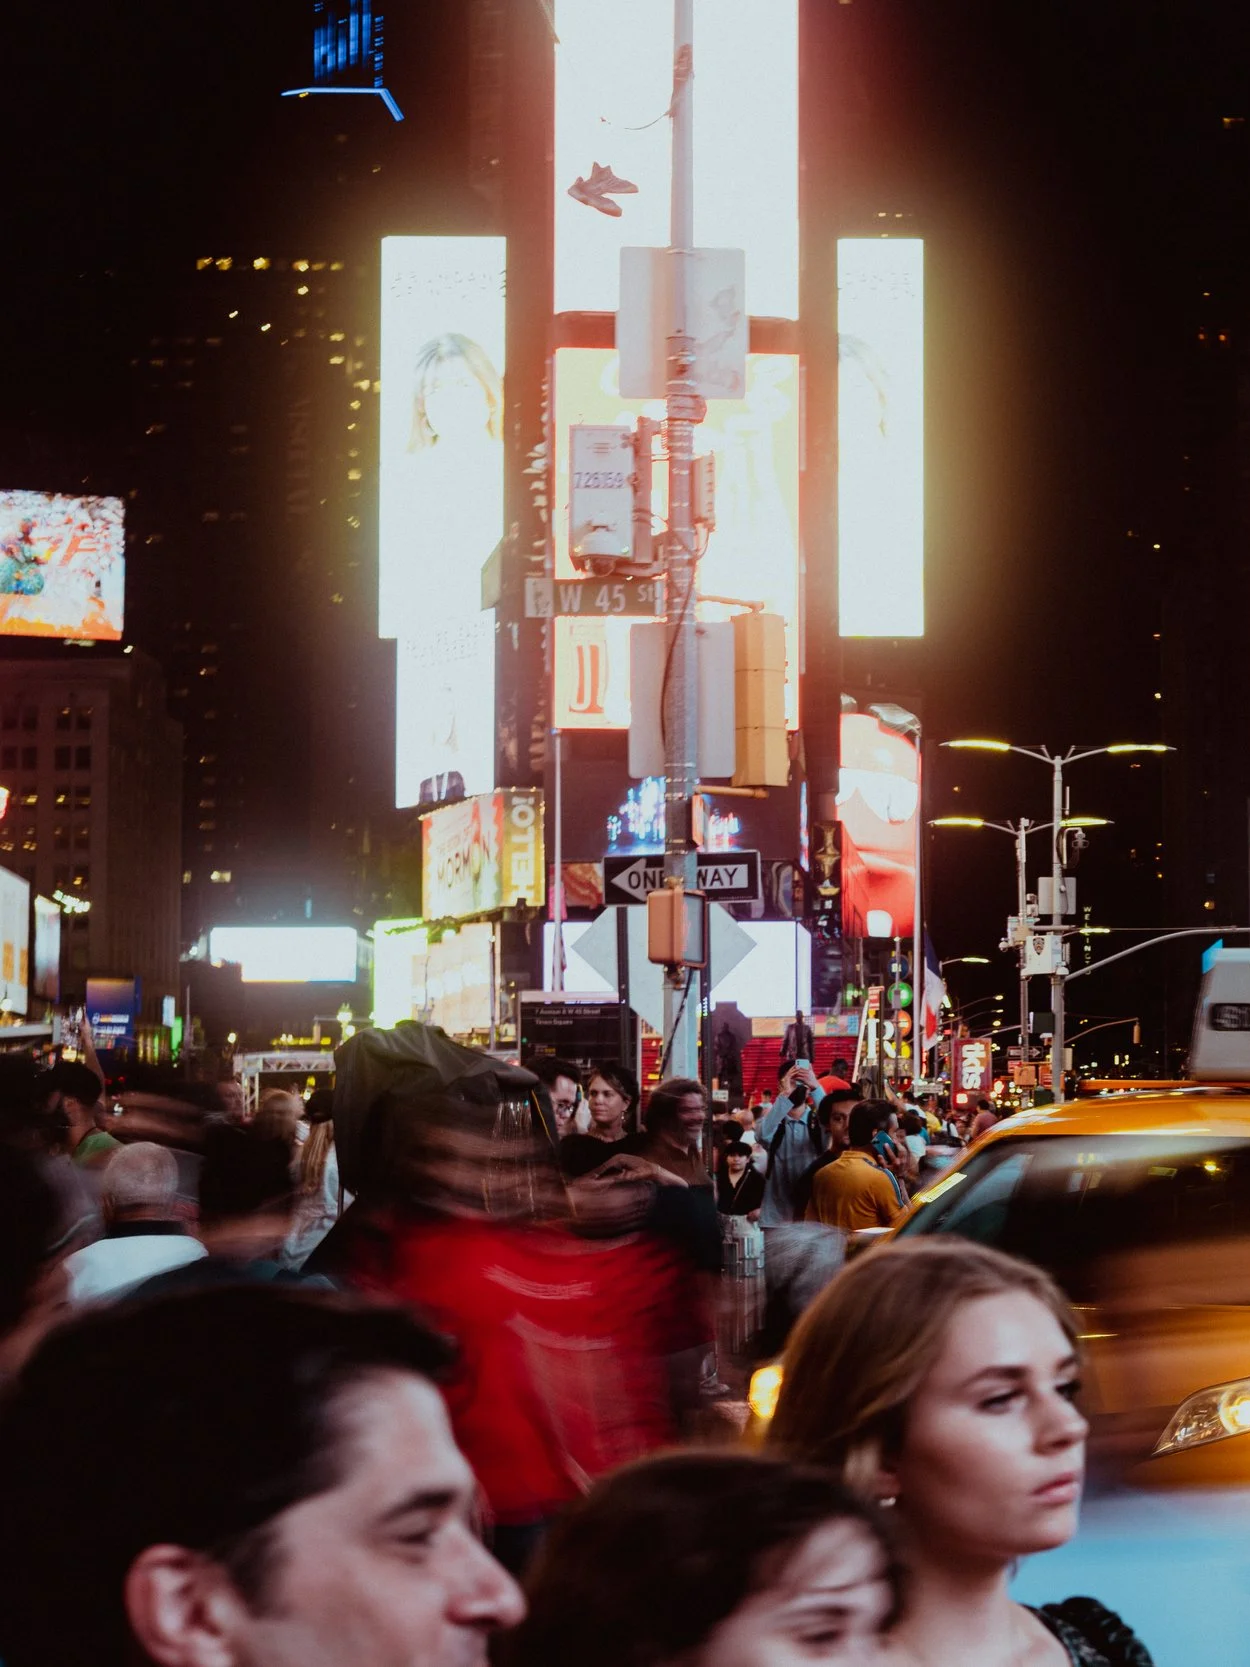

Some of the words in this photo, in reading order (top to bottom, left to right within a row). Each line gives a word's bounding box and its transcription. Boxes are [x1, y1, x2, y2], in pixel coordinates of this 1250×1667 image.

[559, 584, 582, 613] W
[595, 584, 626, 612] 45
[637, 583, 656, 602] St
[437, 831, 490, 889] MORMON
